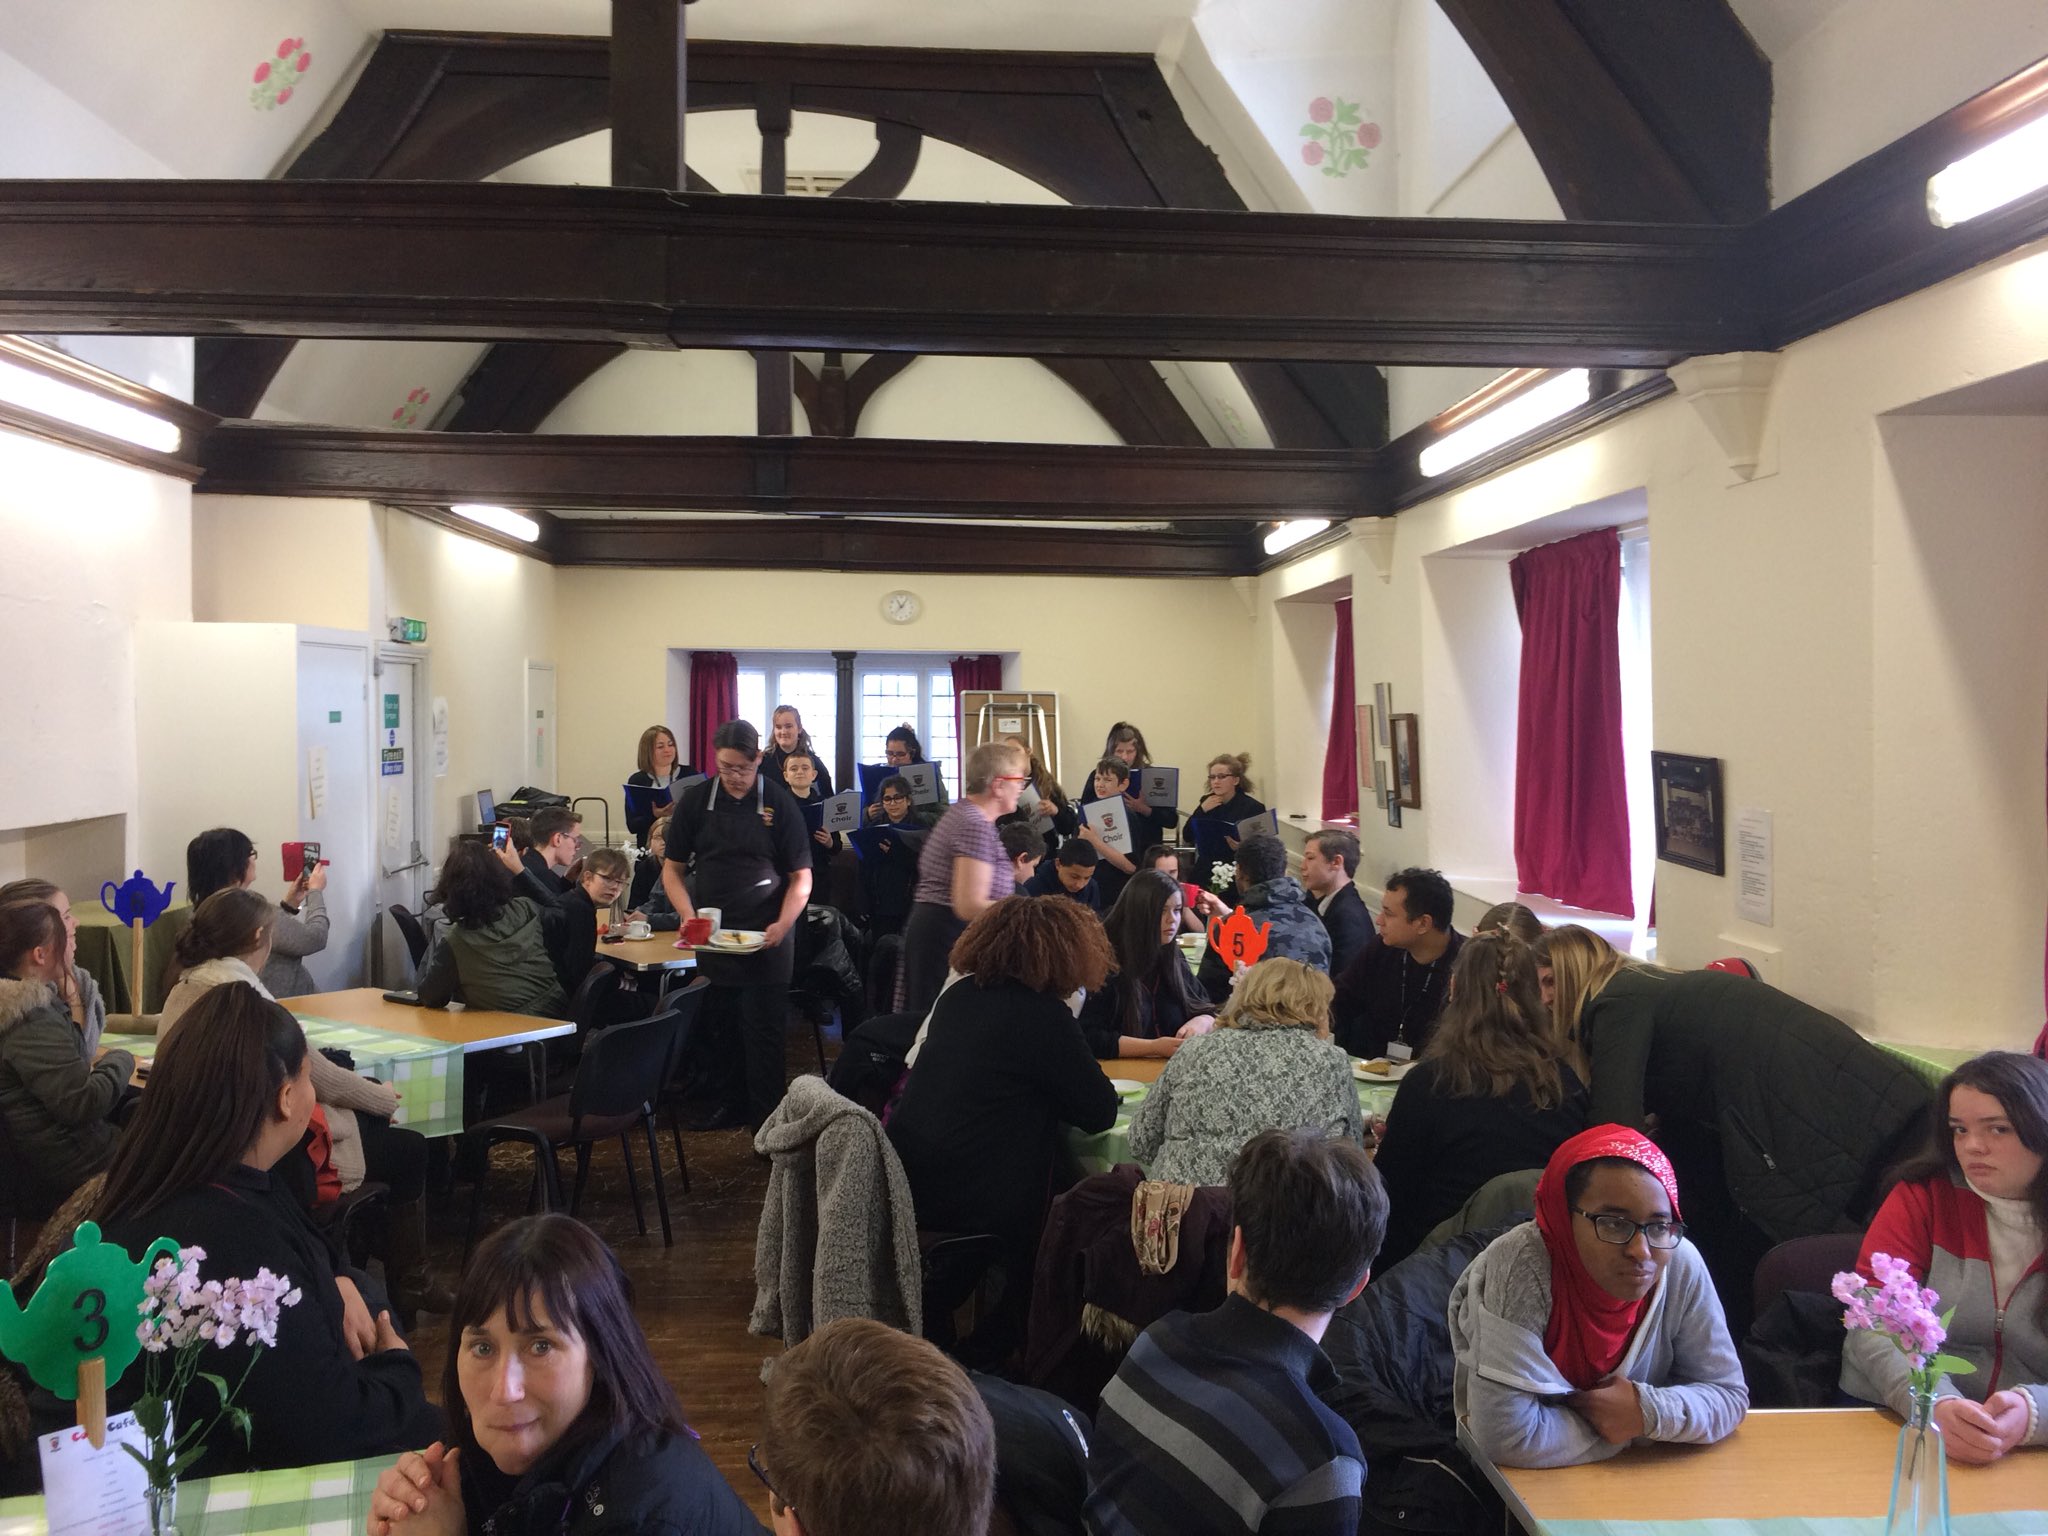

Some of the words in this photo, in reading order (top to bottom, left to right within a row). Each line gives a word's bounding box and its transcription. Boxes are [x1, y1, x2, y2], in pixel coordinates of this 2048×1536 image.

[831, 815, 852, 823] Choir
[1102, 832, 1123, 844] Choir
[1232, 932, 1245, 957] 5
[72, 1288, 110, 1351] 3
